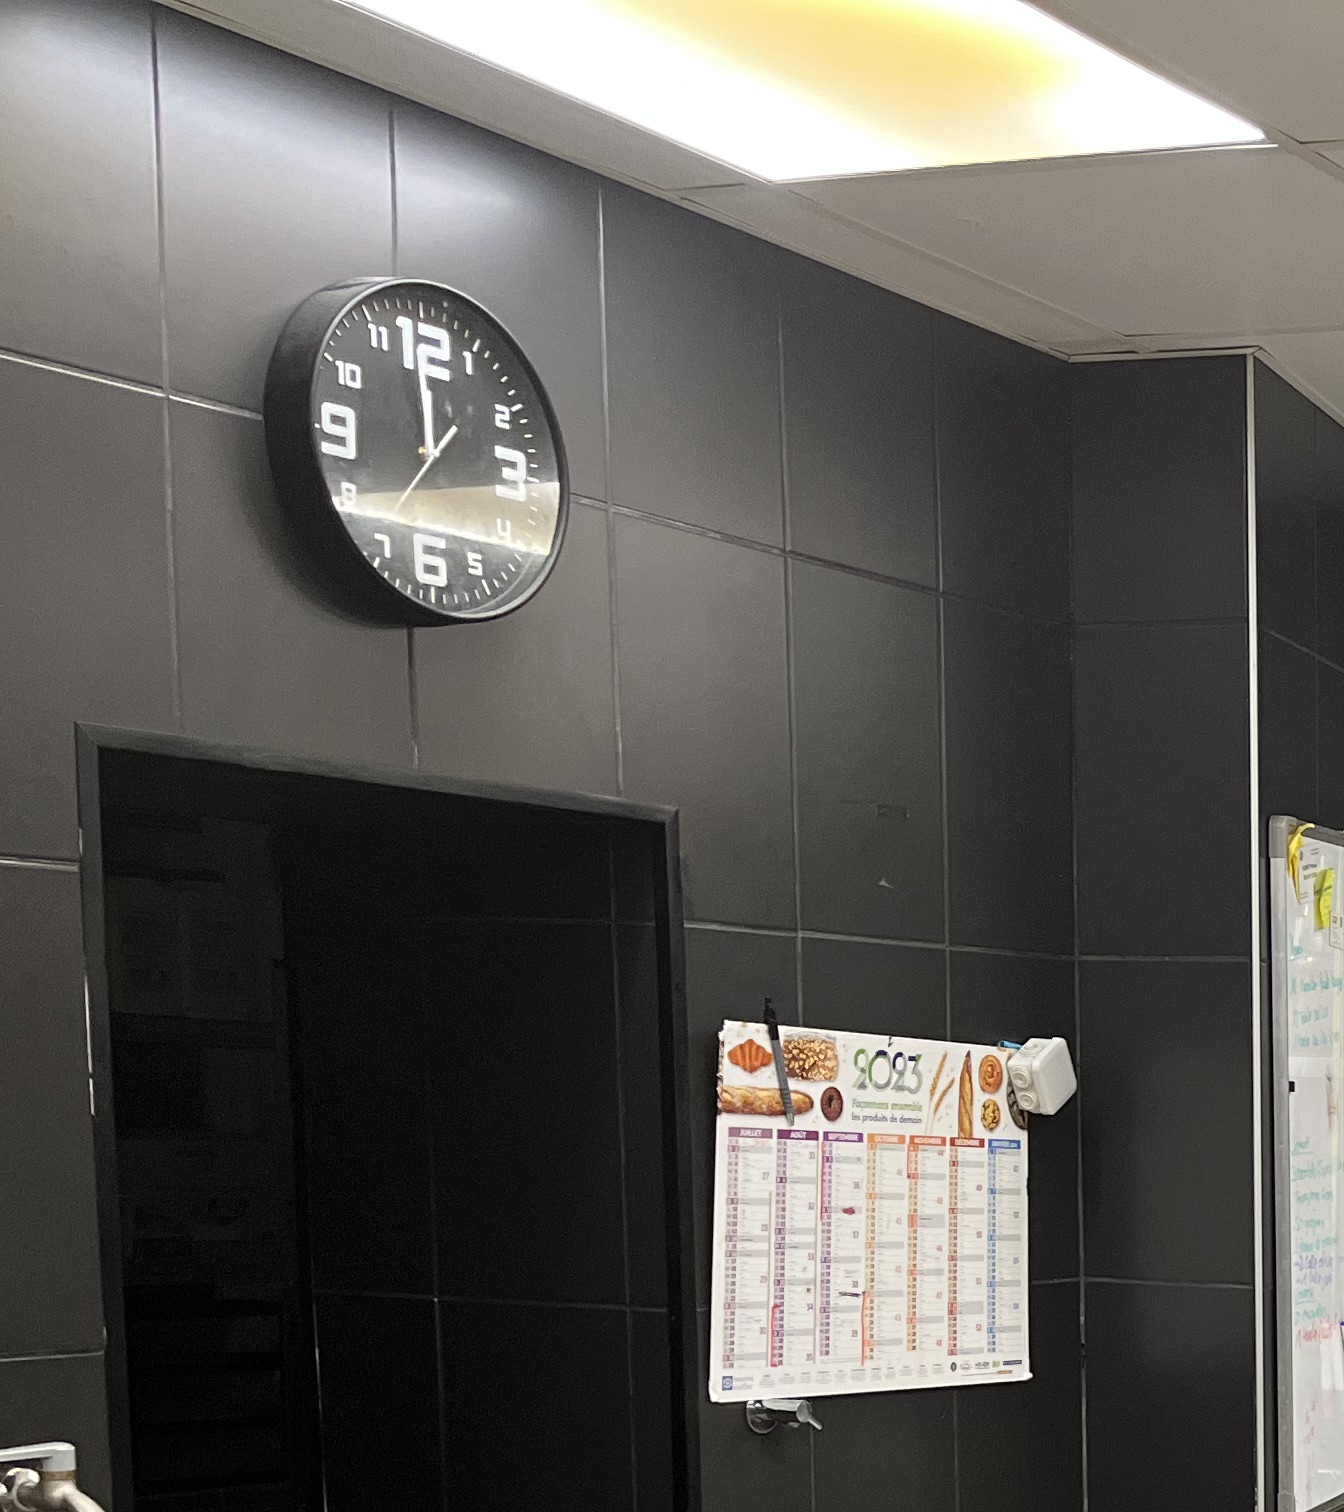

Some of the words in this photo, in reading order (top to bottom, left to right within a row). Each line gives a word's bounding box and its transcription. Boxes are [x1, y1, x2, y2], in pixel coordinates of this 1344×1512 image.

[367, 323, 390, 351] 11
[395, 315, 451, 381] 12
[334, 360, 362, 389] 10
[462, 350, 473, 375] 1
[320, 401, 358, 460] 9
[494, 403, 511, 430] 2
[494, 445, 528, 502] 3
[340, 481, 358, 509] 8
[496, 518, 512, 542] 4
[374, 533, 392, 559] 7
[412, 532, 448, 588] 6
[467, 551, 483, 576] 5
[852, 1048, 924, 1095] 2023
